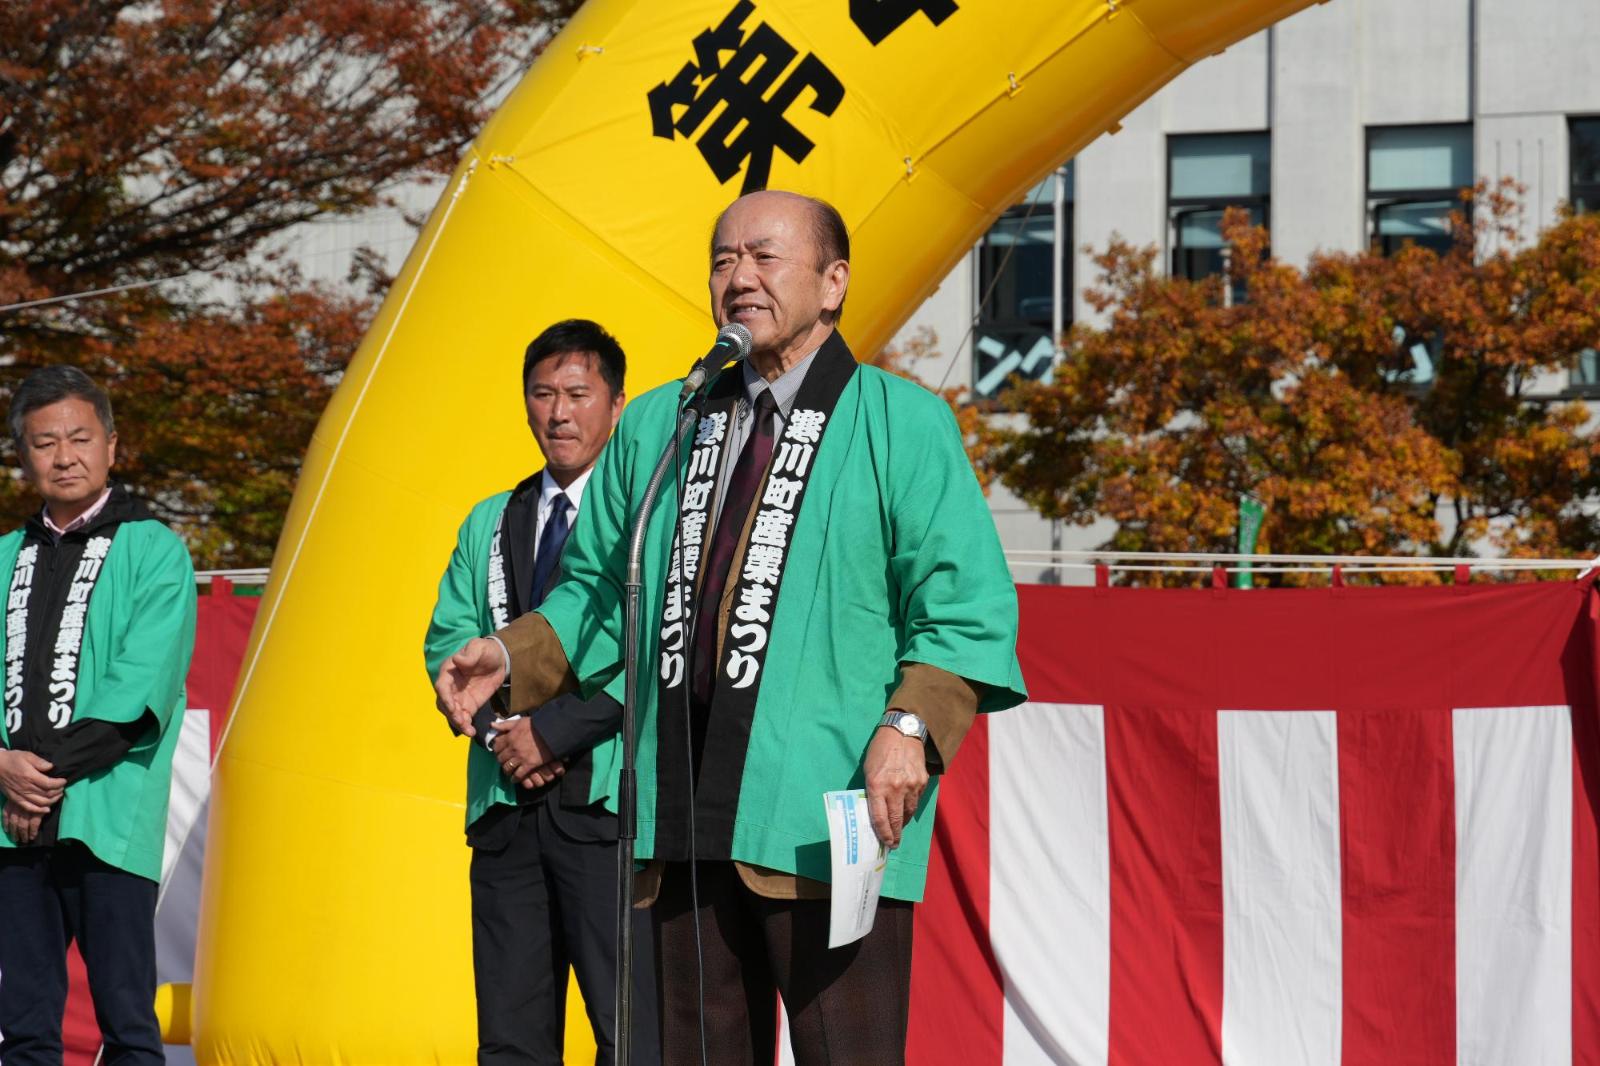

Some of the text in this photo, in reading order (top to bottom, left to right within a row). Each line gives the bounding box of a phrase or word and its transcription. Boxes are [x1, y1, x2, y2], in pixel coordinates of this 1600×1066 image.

[47, 535, 112, 729] 寒川町産業まつり
[726, 408, 827, 689] 寒川町産業まつり
